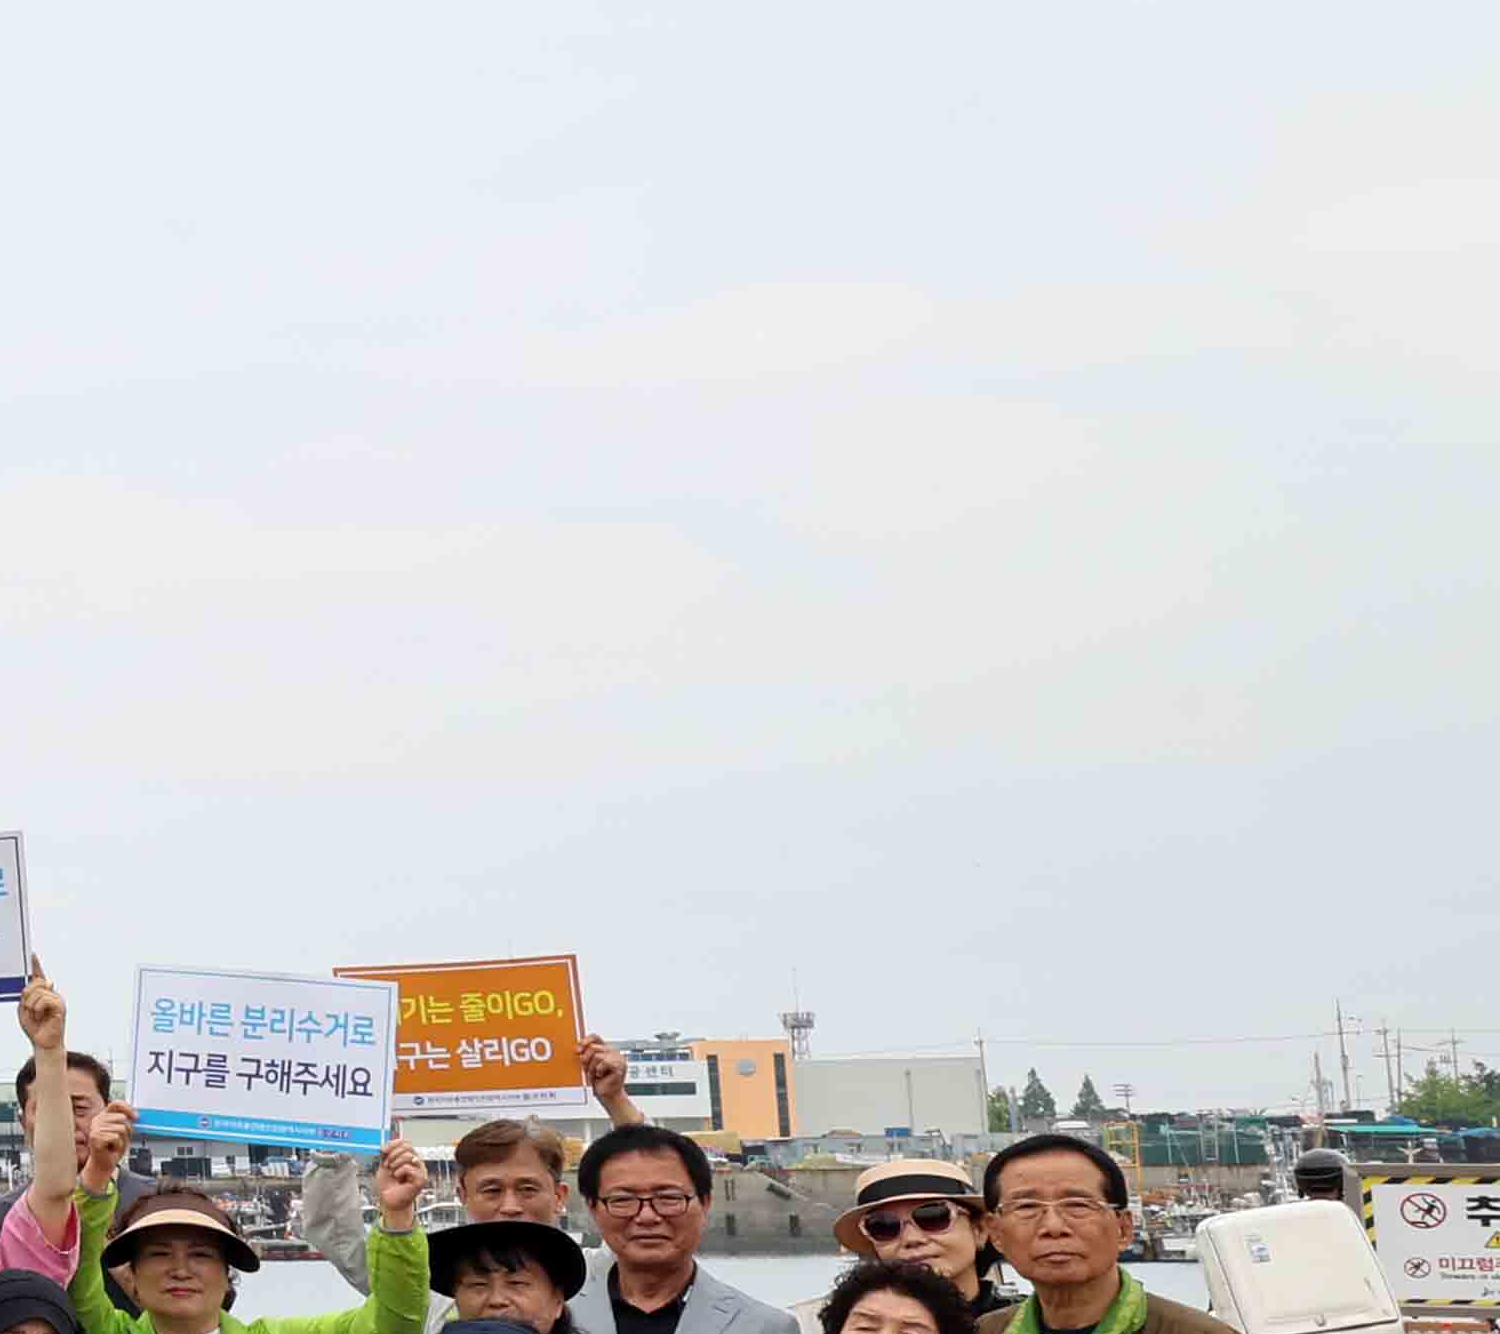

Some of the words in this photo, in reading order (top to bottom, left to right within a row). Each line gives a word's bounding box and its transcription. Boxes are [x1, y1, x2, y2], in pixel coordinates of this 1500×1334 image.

[151, 999, 234, 1034] 올바른
[241, 1005, 376, 1048] 분리수거로
[460, 991, 564, 1023] 줄이GO,
[457, 1036, 552, 1067] 살리GO
[147, 1049, 230, 1090] 지구를
[236, 1058, 374, 1099] 구해주세요
